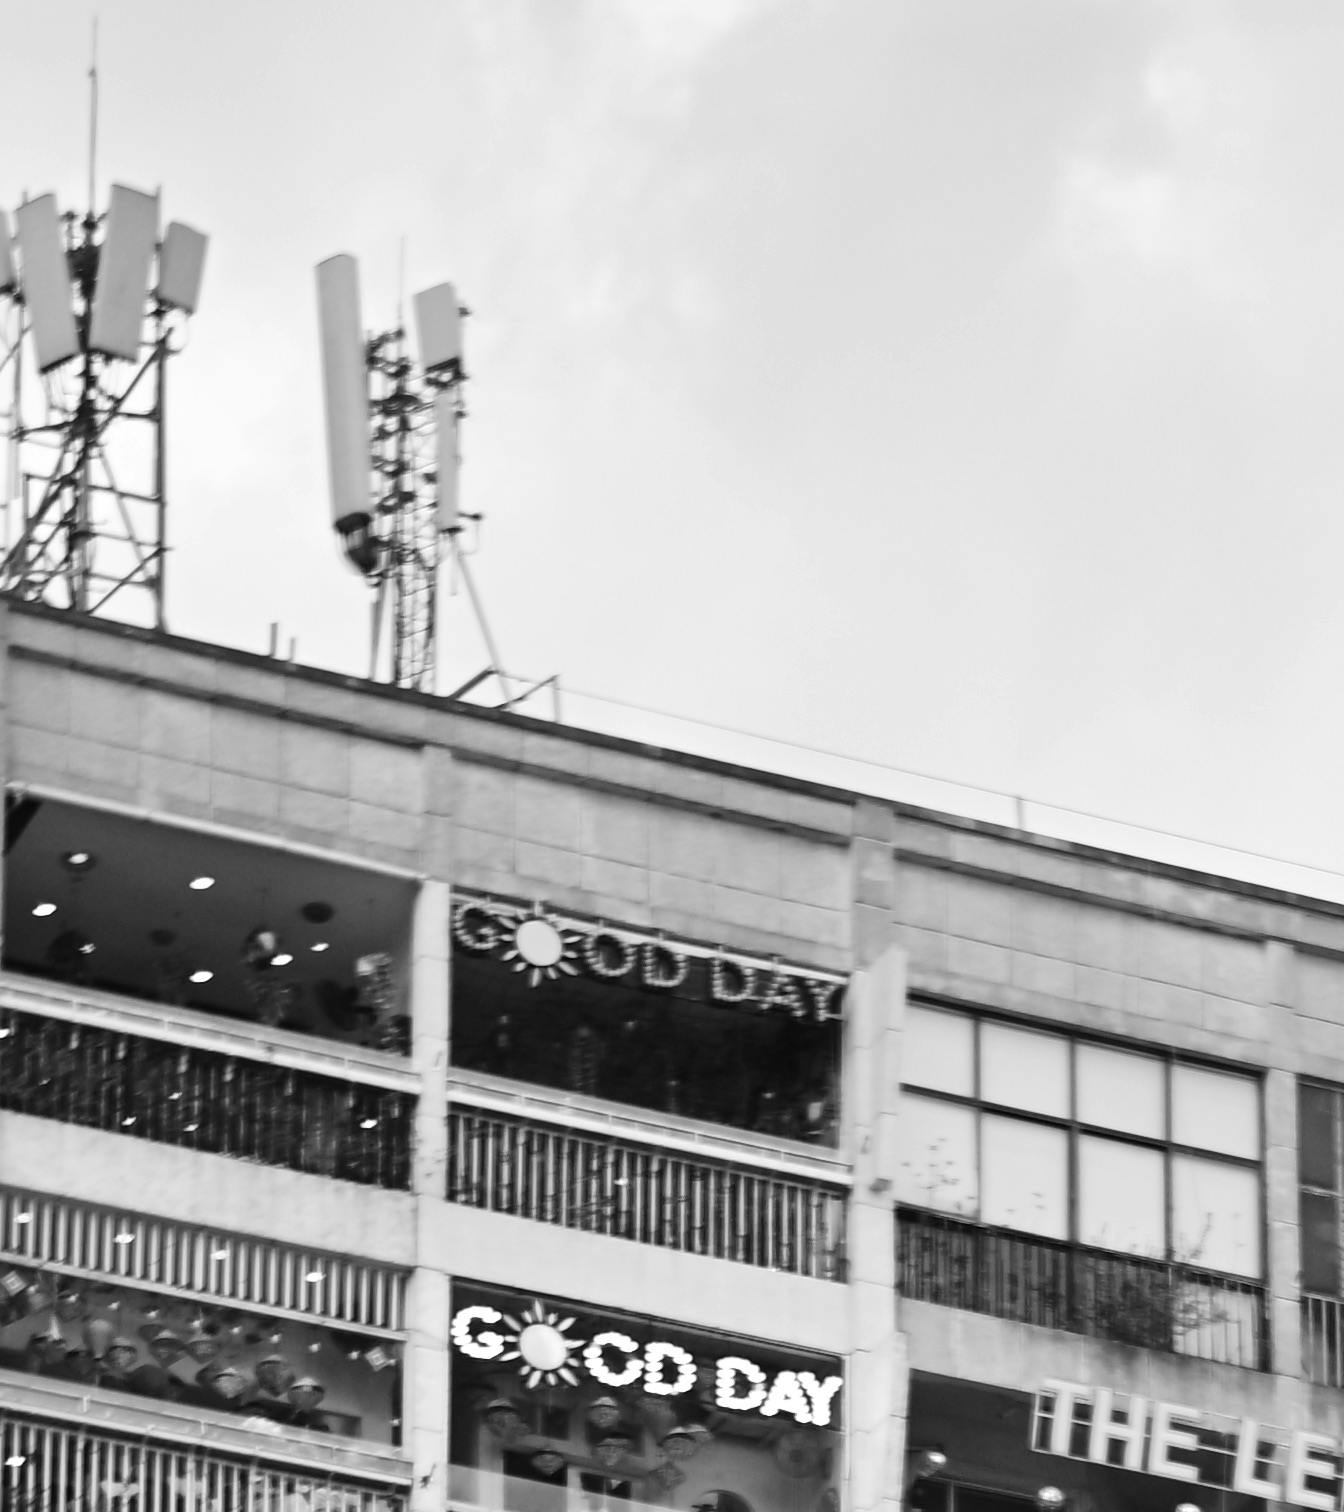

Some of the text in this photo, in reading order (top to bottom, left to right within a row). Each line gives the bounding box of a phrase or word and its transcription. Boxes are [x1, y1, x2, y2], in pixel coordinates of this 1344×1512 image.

[712, 957, 842, 1022] DAY
[716, 1357, 843, 1426] DAY
[1038, 1378, 1203, 1483] THE
